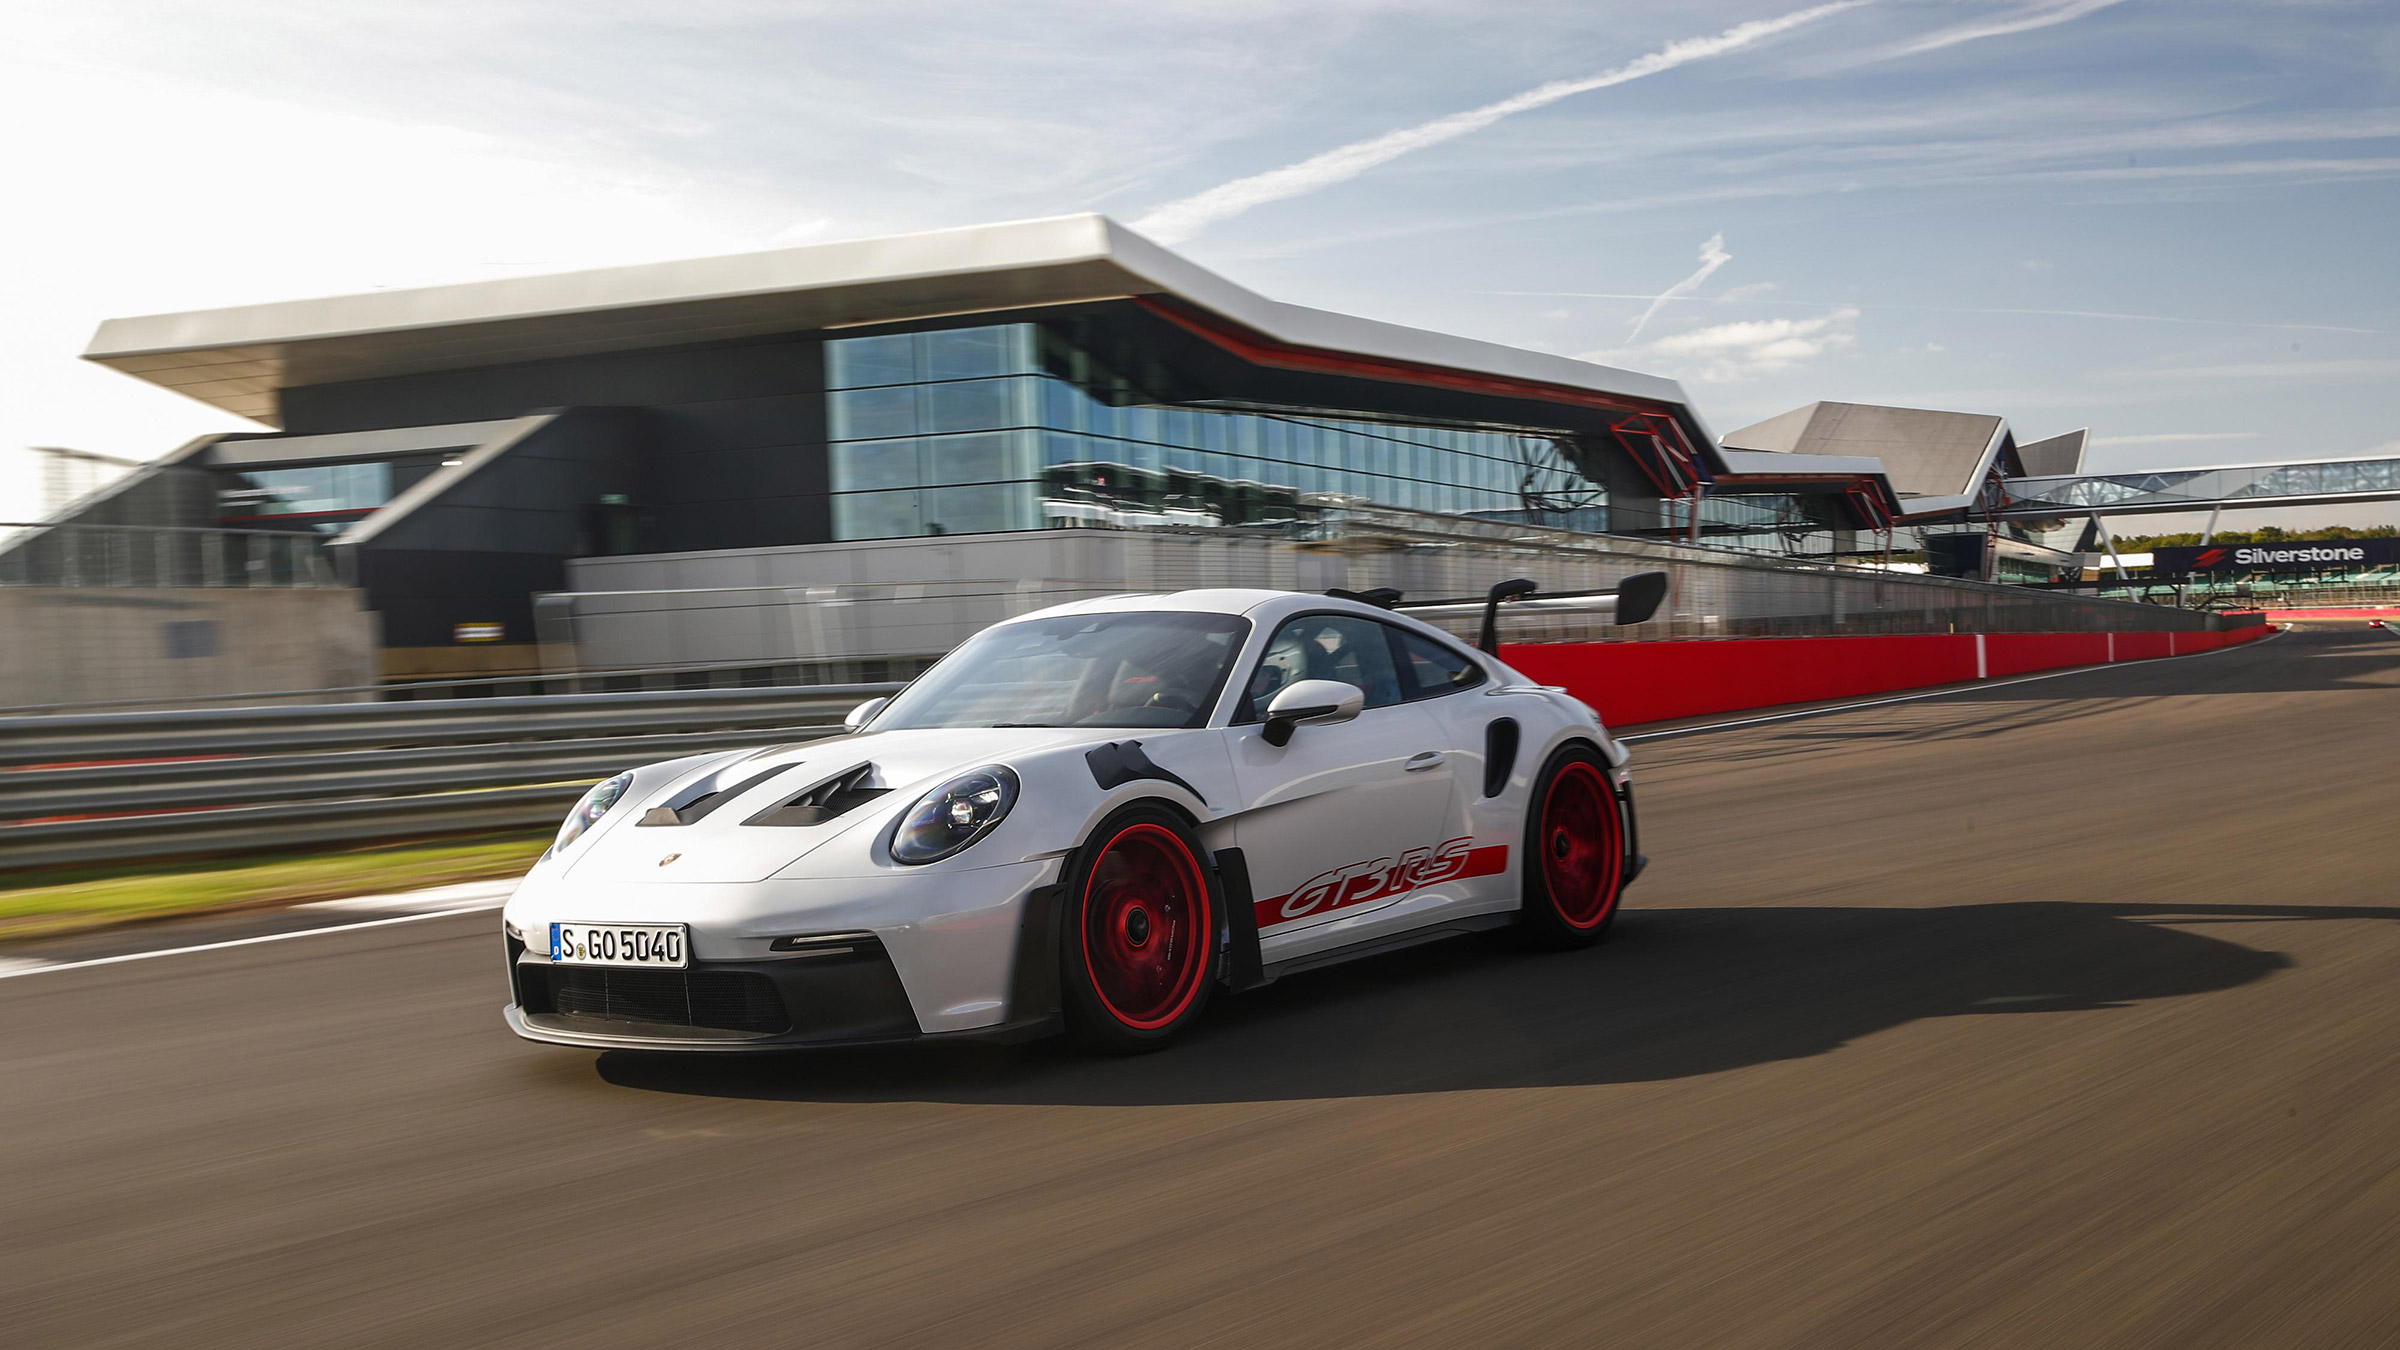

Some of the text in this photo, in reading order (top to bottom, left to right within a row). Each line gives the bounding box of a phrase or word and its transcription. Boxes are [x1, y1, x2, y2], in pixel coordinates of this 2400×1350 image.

[2235, 547, 2364, 564] Silverstone
[562, 929, 681, 961] S GO 5040
